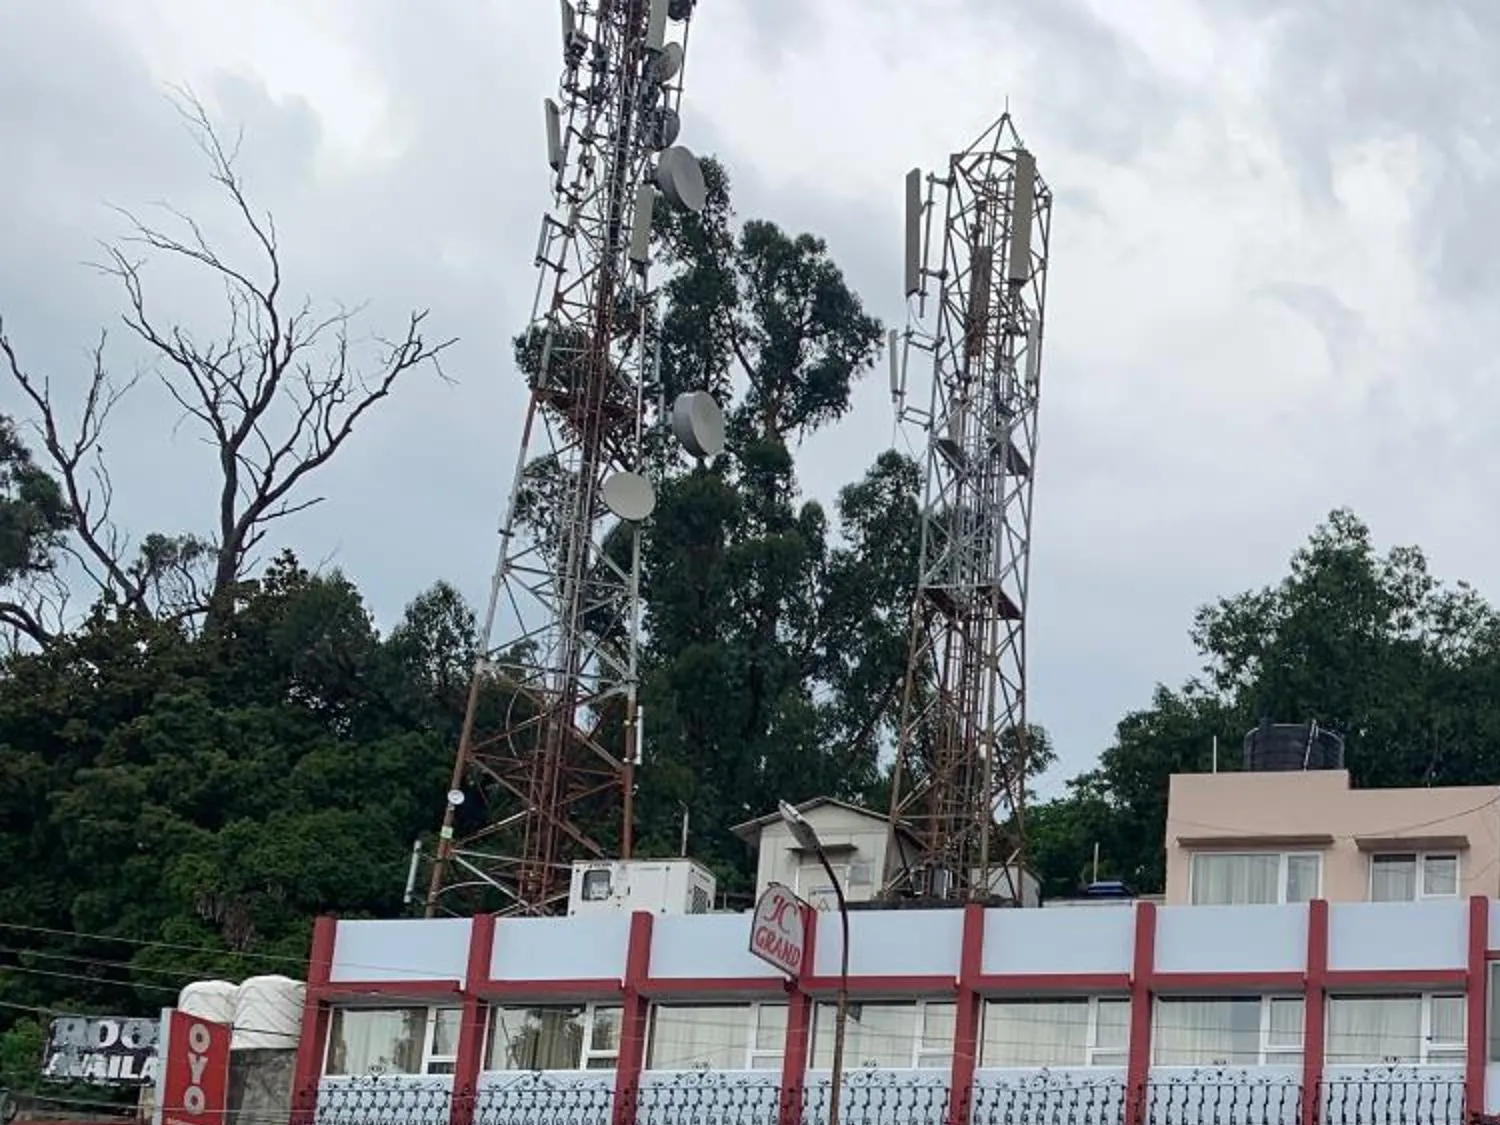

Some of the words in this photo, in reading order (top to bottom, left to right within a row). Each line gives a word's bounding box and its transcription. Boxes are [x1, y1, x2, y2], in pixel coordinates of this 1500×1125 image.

[756, 926, 800, 966] GRAND
[52, 1018, 160, 1050] ROO
[43, 1051, 158, 1080] AVAILA
[184, 1023, 211, 1115] OYO
